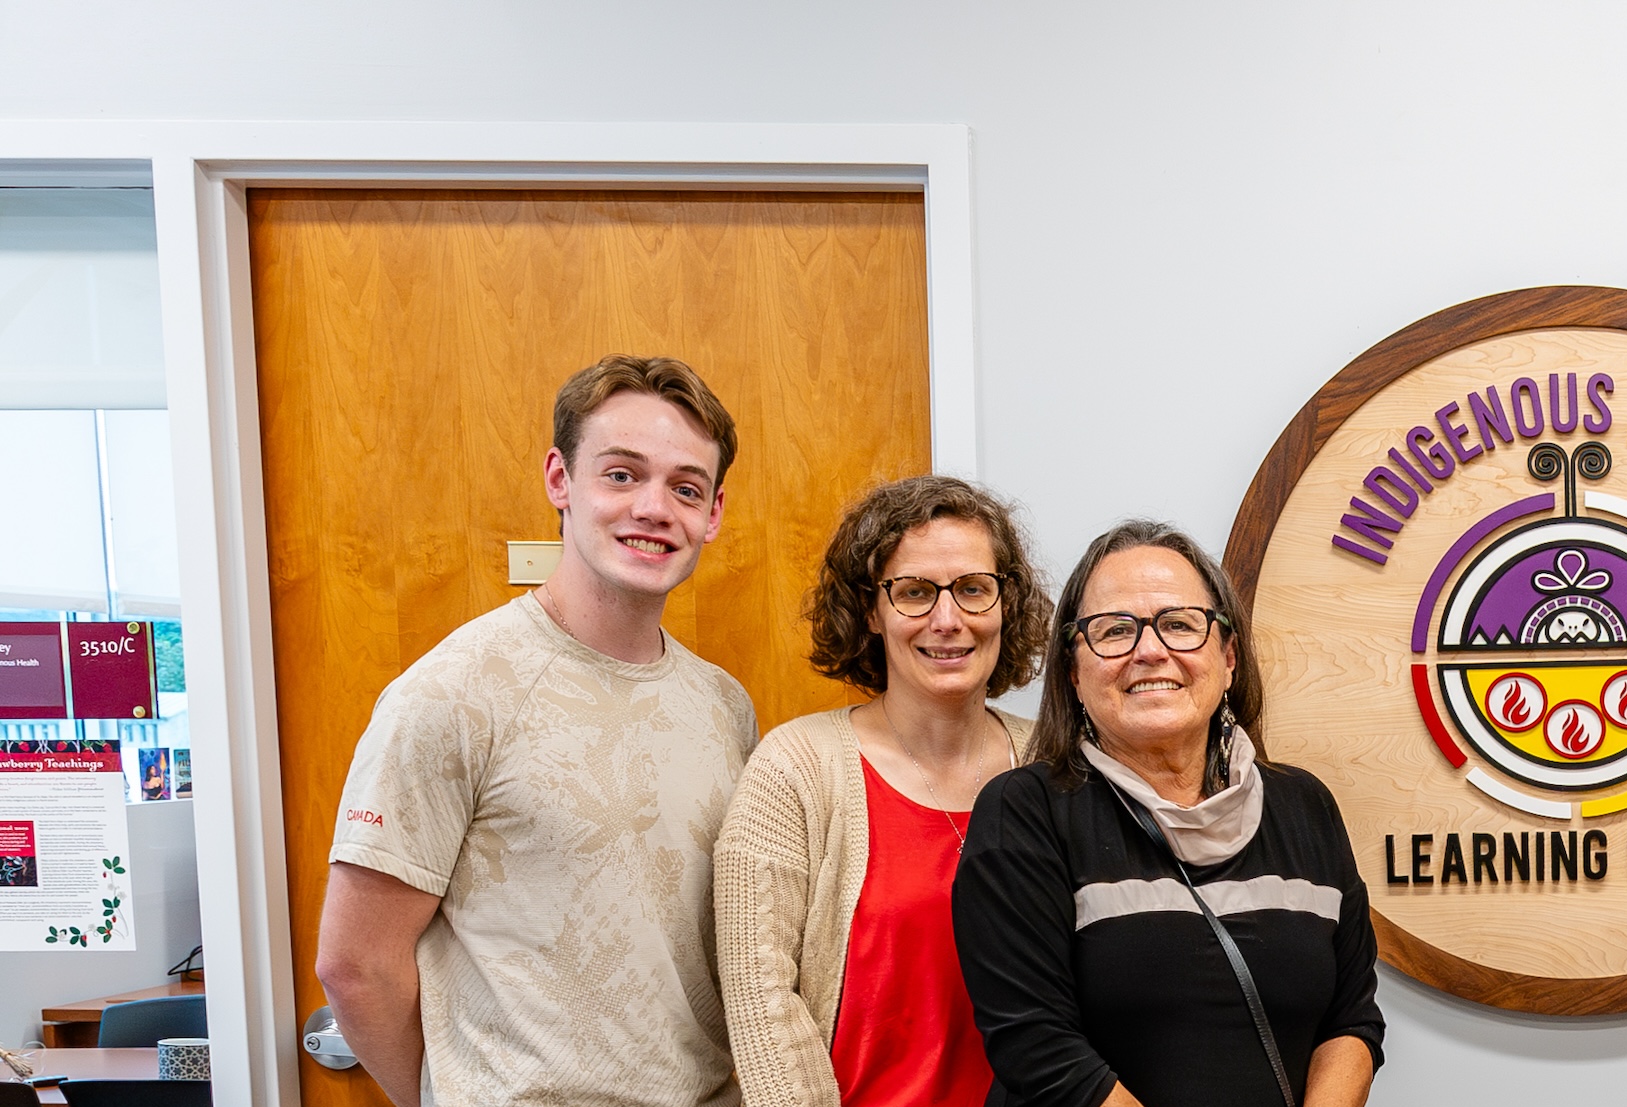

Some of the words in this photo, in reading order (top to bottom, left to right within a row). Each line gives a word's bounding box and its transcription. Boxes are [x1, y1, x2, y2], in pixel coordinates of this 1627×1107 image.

[1332, 372, 1614, 565] INDIGENOUS
[80, 636, 135, 656] 3510/C
[44, 757, 104, 772] Teachings
[1385, 829, 1608, 884] LEARNING
